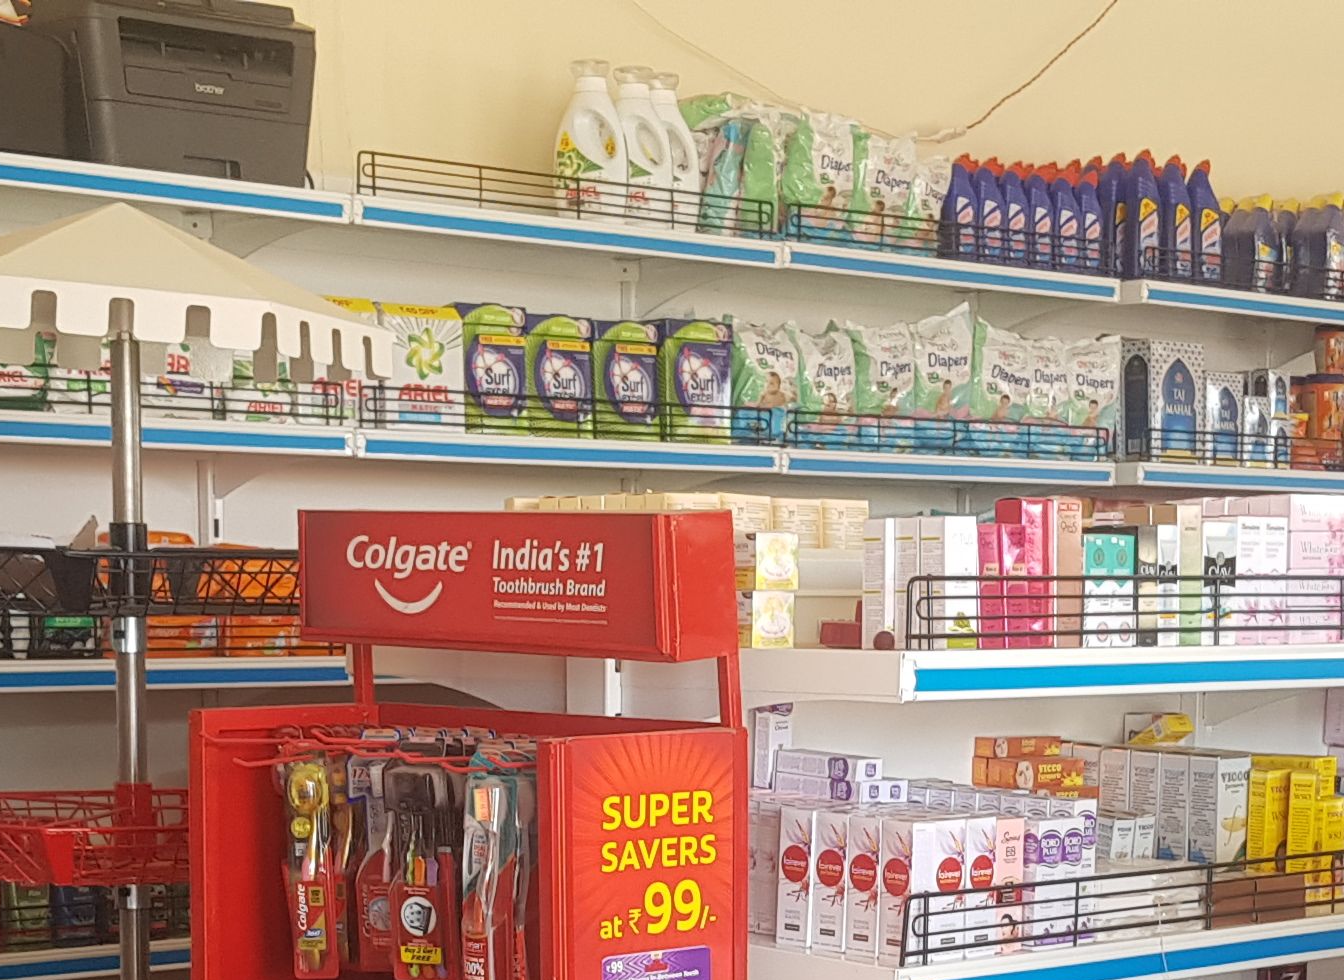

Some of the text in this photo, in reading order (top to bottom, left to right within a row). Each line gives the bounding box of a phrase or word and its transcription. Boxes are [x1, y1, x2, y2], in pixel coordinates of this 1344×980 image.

[195, 82, 225, 95] brother
[755, 342, 794, 361] Diapers
[927, 350, 968, 369] Diapers
[484, 368, 511, 386] Surf
[691, 374, 715, 392] Surf
[991, 365, 1030, 390] Diapers
[399, 384, 454, 404] ARIEL
[1173, 388, 1186, 401] TAJ
[1166, 404, 1193, 416] MAHAL
[347, 535, 469, 579] Colgate
[492, 540, 604, 573] India's #1
[492, 577, 605, 597] Toothbrush Brand
[493, 600, 535, 610] Recommended
[537, 602, 541, 610] &
[558, 603, 564, 612] by
[1038, 763, 1062, 774] VICCO
[1220, 770, 1249, 783] VICCO
[602, 790, 714, 832] SUPER
[1041, 838, 1060, 849] BORO
[601, 834, 717, 873] SAVERS
[600, 917, 623, 939] at
